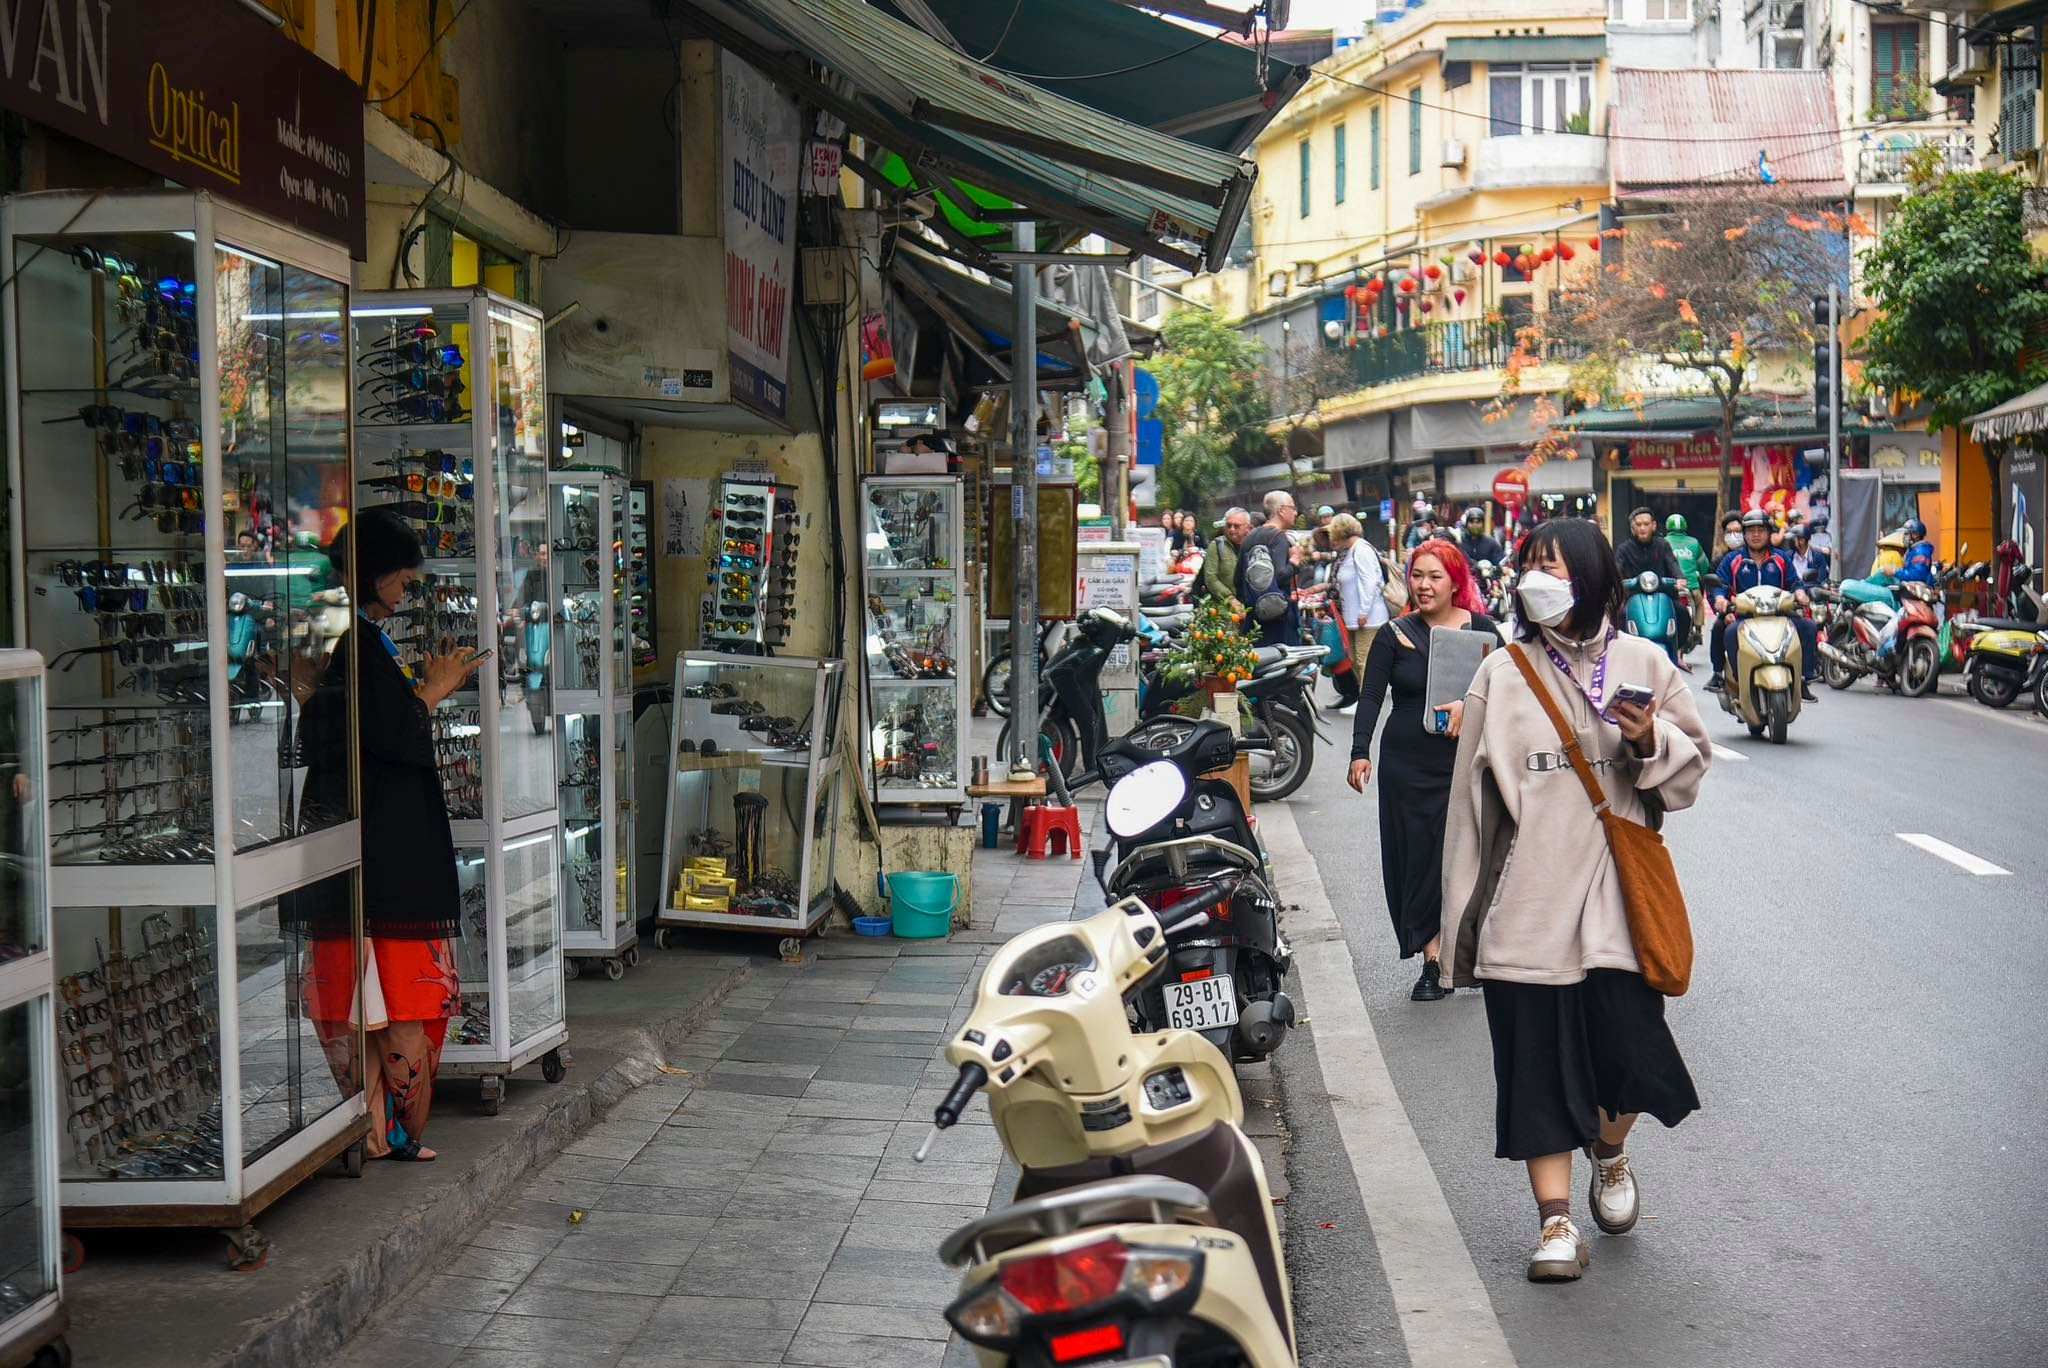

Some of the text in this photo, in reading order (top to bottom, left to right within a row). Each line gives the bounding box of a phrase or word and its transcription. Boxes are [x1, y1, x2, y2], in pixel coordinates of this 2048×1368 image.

[148, 62, 241, 176] Optical
[734, 153, 786, 245] HIỆU KÍNH
[1673, 547, 1693, 560] rab
[1174, 979, 1222, 1007] 29-B1
[1171, 1001, 1230, 1029] 693.17
